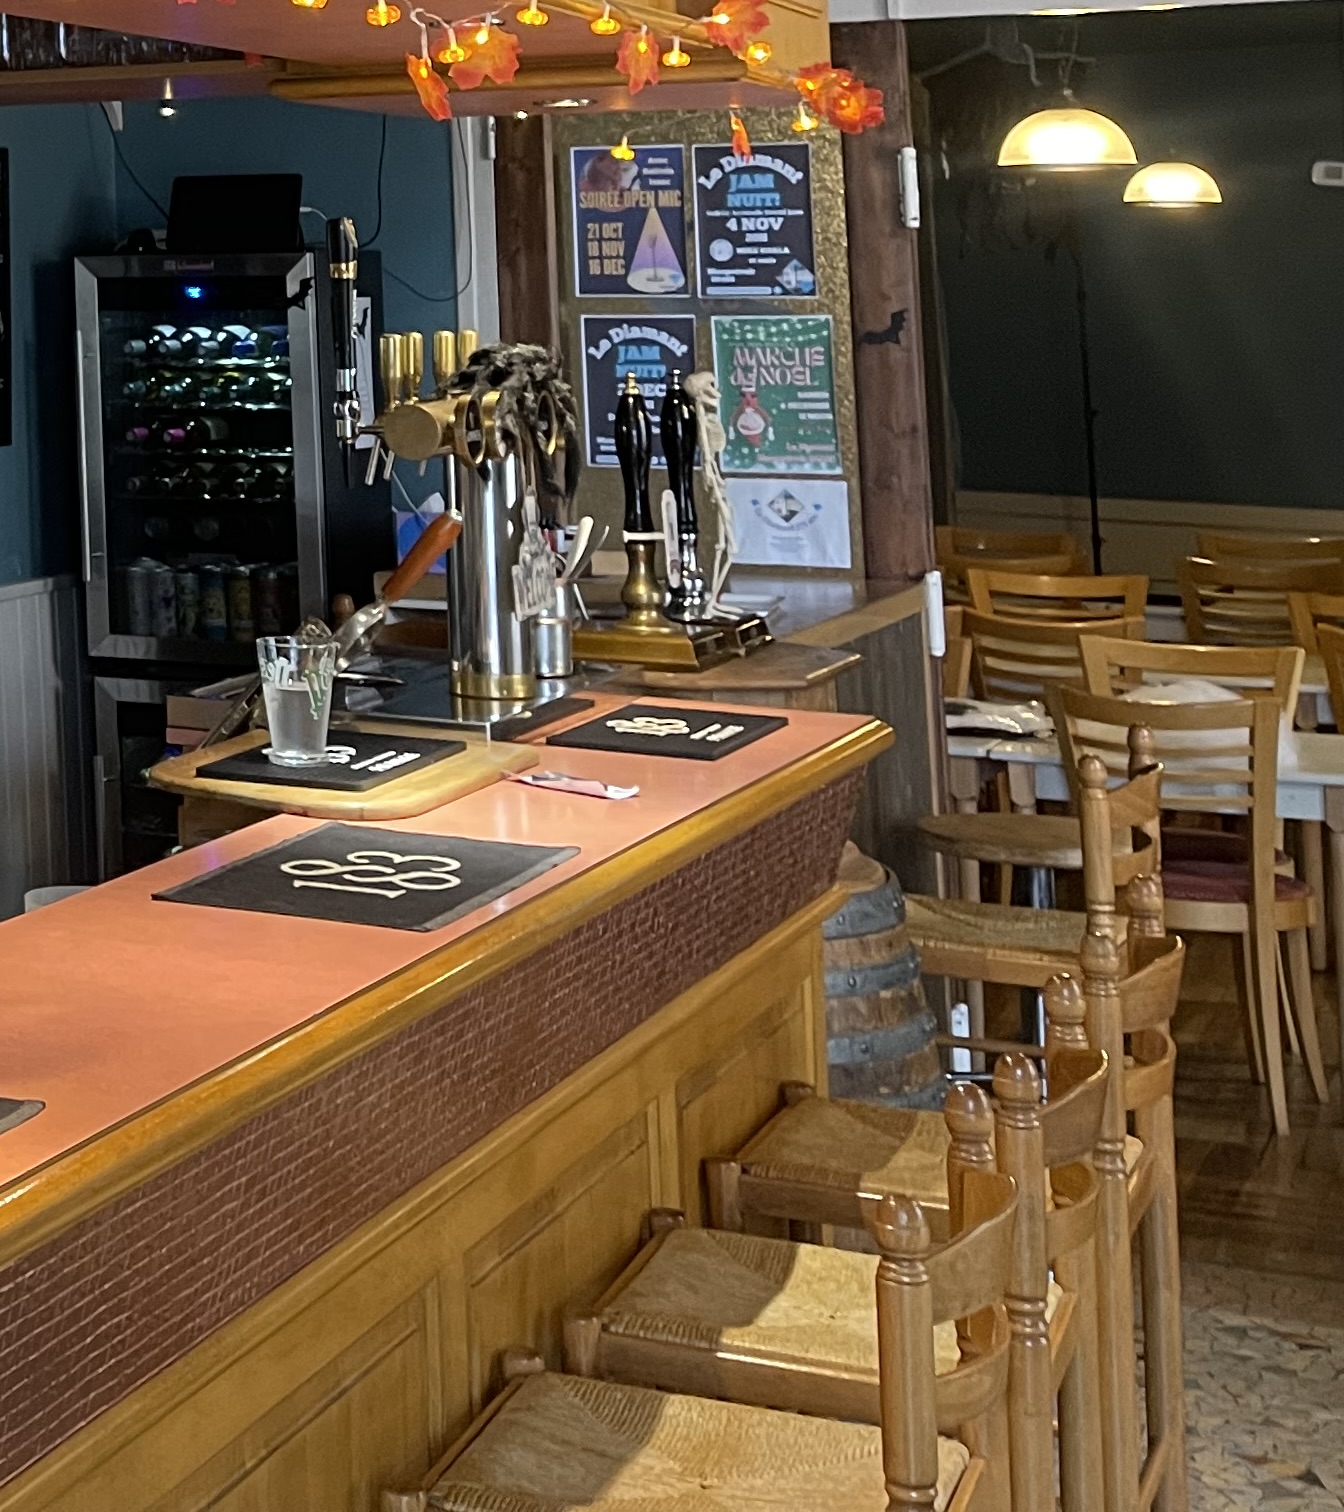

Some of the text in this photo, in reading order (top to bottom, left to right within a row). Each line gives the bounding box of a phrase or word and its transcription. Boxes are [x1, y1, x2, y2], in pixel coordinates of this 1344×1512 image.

[728, 173, 775, 193] JAM
[623, 190, 655, 208] OPEN
[658, 189, 683, 207] MIC
[587, 222, 624, 239] 21 OCT
[741, 216, 785, 232] NOV
[601, 240, 625, 257] NOV
[603, 258, 626, 275] DEC
[617, 345, 661, 364] JAM
